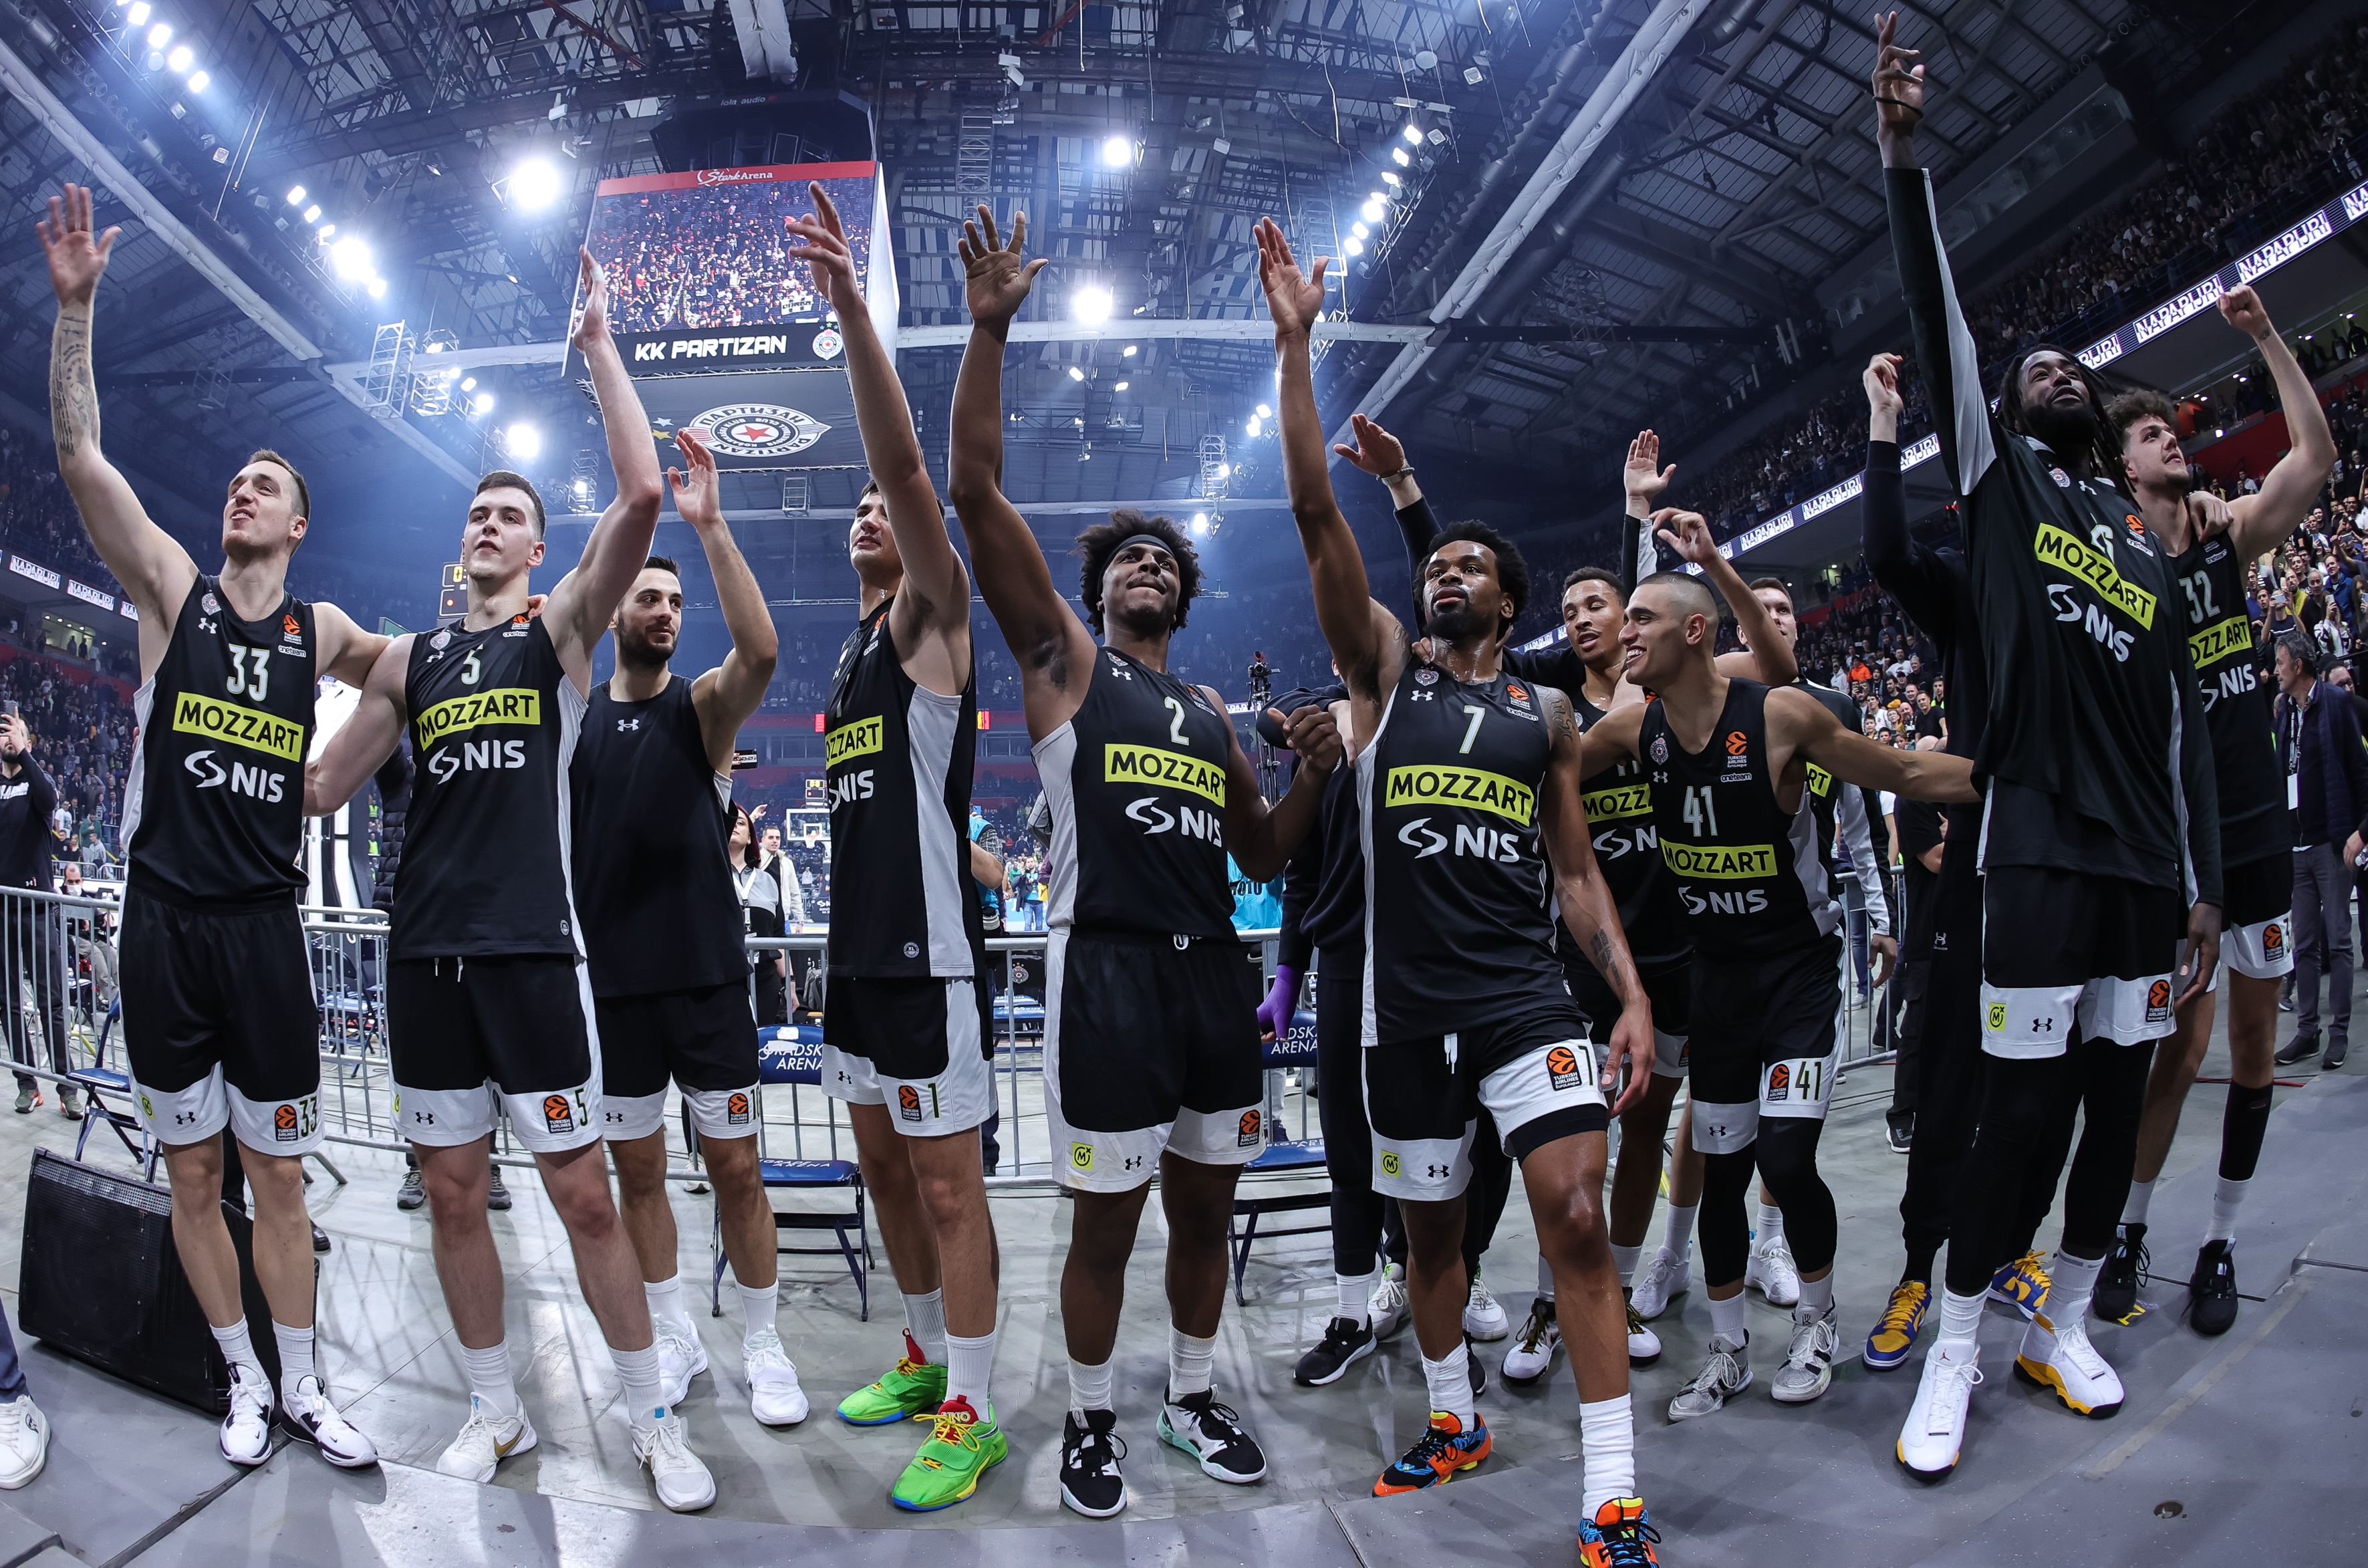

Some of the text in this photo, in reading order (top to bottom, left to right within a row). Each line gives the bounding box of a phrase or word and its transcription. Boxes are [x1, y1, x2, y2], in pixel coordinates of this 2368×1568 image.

[635, 335, 787, 362] KK PARTIZAN
[699, 406, 807, 426] ПАРТИЗАН
[713, 438, 812, 455] PARTIZAN
[2038, 531, 2151, 620] MOZZART
[2178, 570, 2220, 624] 32
[2085, 604, 2135, 662] NIS
[226, 644, 269, 701] 33
[2220, 664, 2256, 699] NIS
[178, 700, 299, 754] MOZZART
[420, 694, 535, 743] MOZZART
[1164, 696, 1189, 746] 2
[1459, 705, 1485, 753] 7
[465, 740, 525, 772] NIS
[826, 723, 880, 763] OZZART
[231, 762, 285, 803] NIS
[838, 769, 874, 803] NIS
[1111, 751, 1226, 802] MOZZART
[1390, 771, 1532, 817] MOZZART
[1720, 773, 1752, 783] oneteam
[1583, 790, 1650, 817] MOZZ
[1683, 786, 1718, 836] 41
[1180, 806, 1222, 847] NIS
[1455, 824, 1520, 863] NIS
[1664, 842, 1770, 874] MOZZART
[1709, 889, 1768, 914] NIS
[776, 1057, 823, 1070] ARENA
[1271, 1039, 1317, 1054] ARENA
[1553, 1072, 1577, 1081] TURKISH
[1555, 1076, 1579, 1085] AIRLINES
[1555, 1081, 1580, 1089] EuroLeague
[1795, 1061, 1821, 1101] 41
[299, 1095, 317, 1137] 33
[575, 1087, 588, 1126] 5
[927, 1083, 940, 1118] 1
